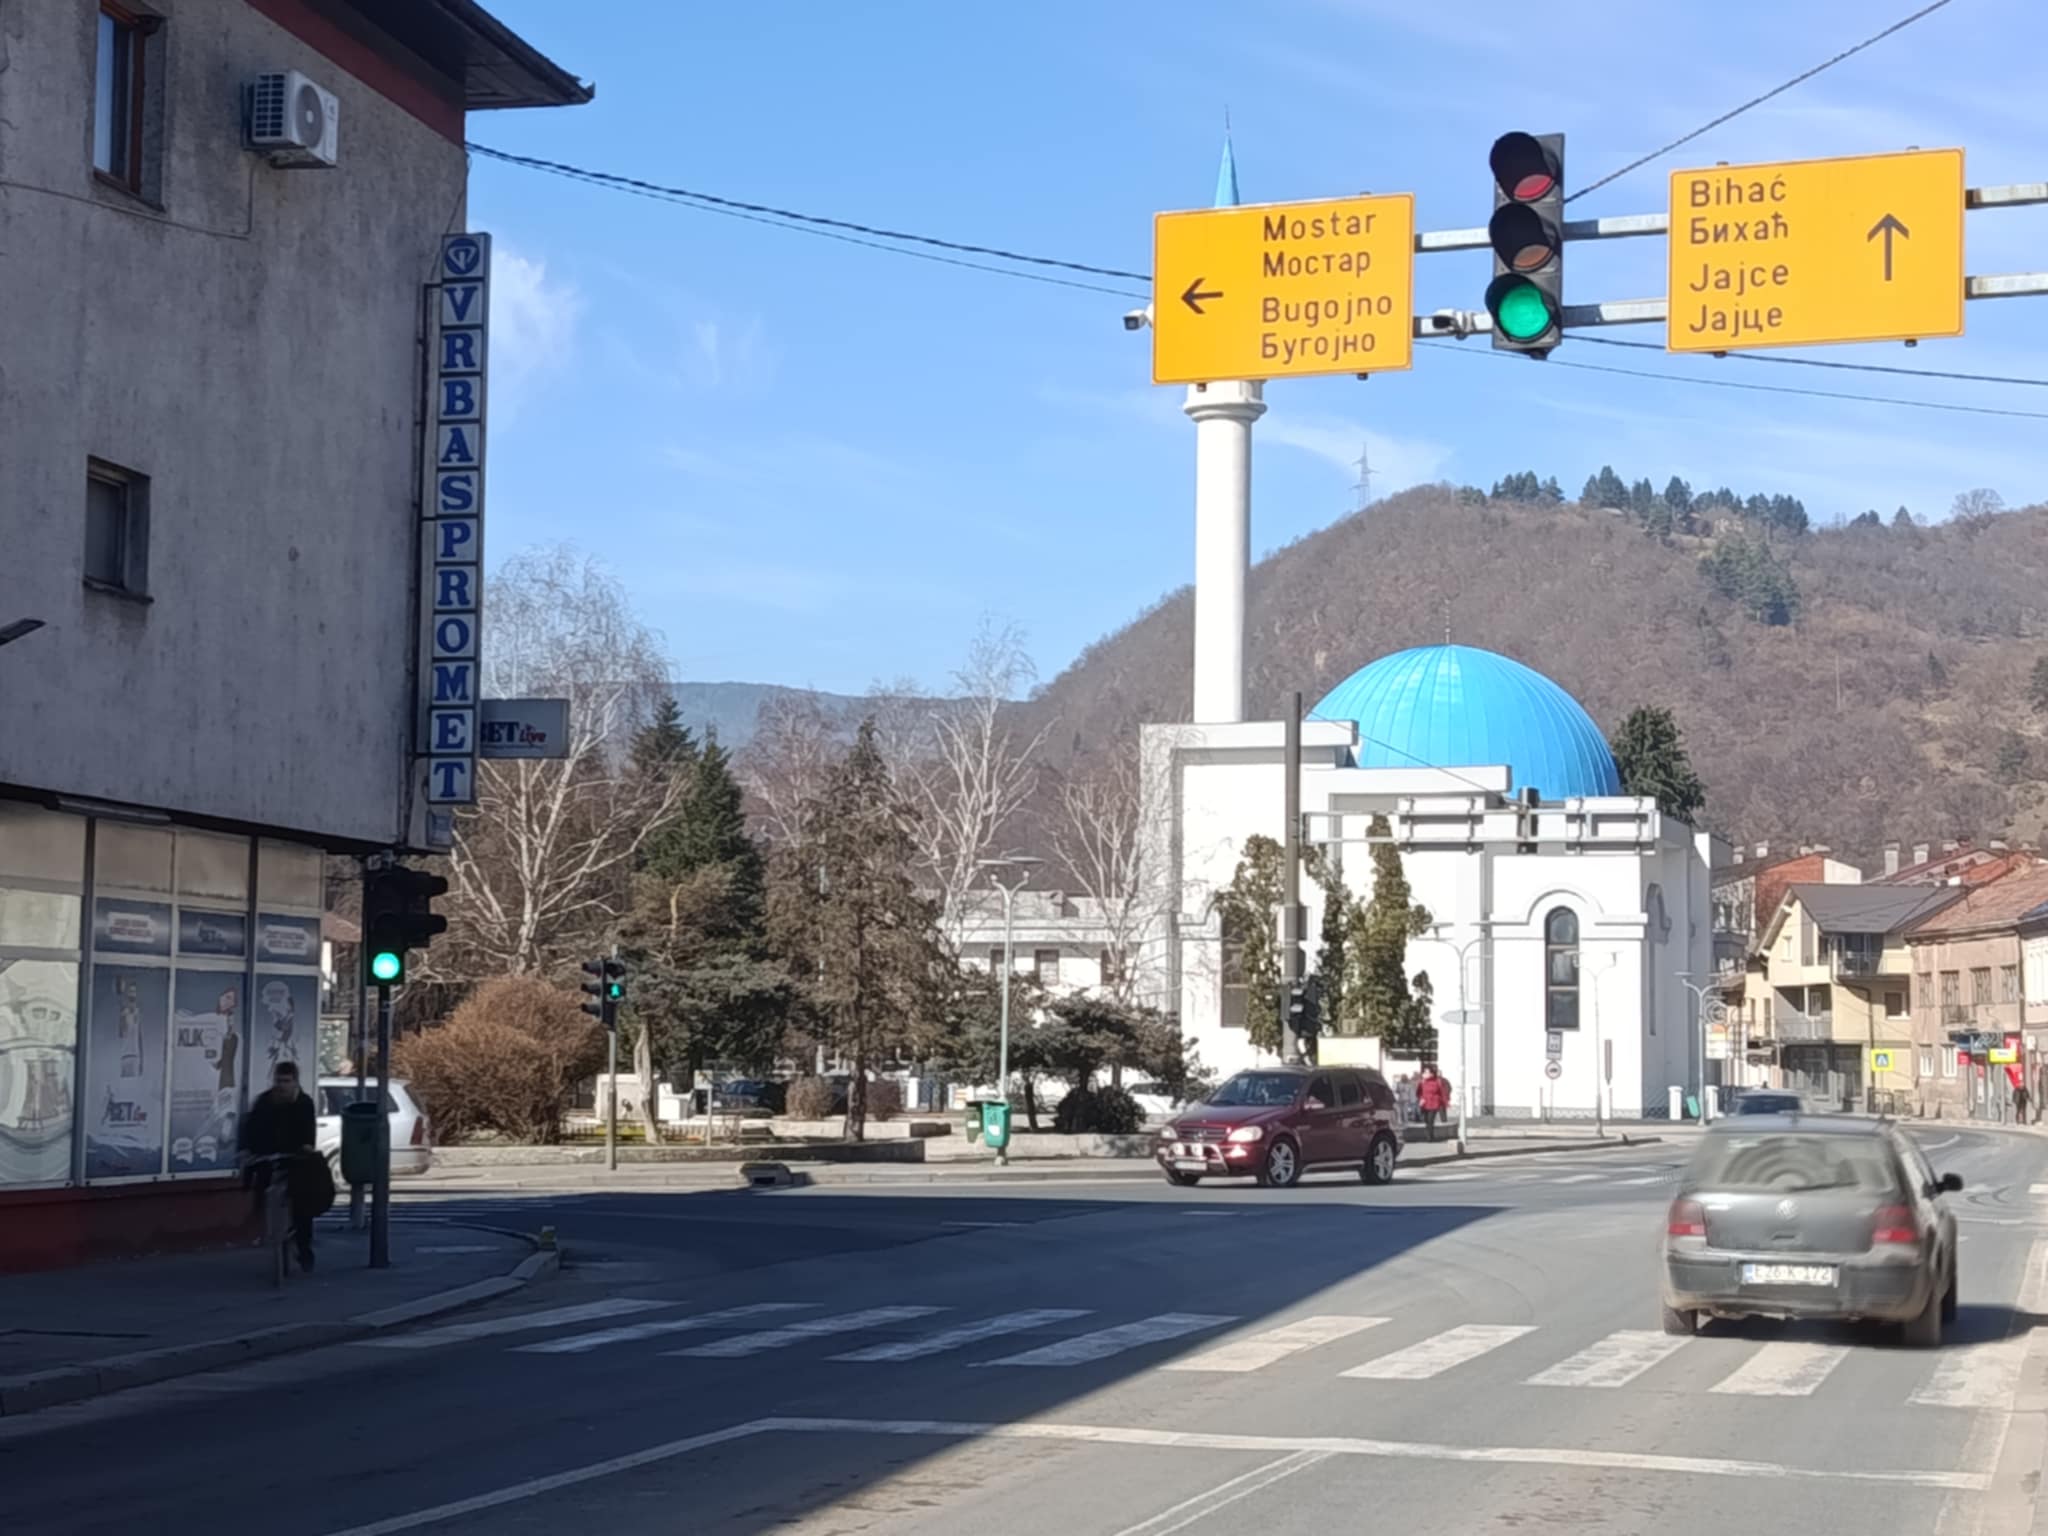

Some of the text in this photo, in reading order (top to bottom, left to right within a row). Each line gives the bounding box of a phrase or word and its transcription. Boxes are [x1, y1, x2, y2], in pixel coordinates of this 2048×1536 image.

[1690, 174, 1787, 208] Bihać
[1263, 211, 1377, 242] Mostar
[1690, 211, 1789, 245] Бихаћ
[1263, 251, 1371, 279] Мостар
[1689, 262, 1789, 296] Jajce
[1262, 293, 1392, 328] Bugojno
[1689, 304, 1783, 338] Јајце
[1261, 329, 1376, 365] Бугојно
[433, 286, 478, 798] VRBASPROMET
